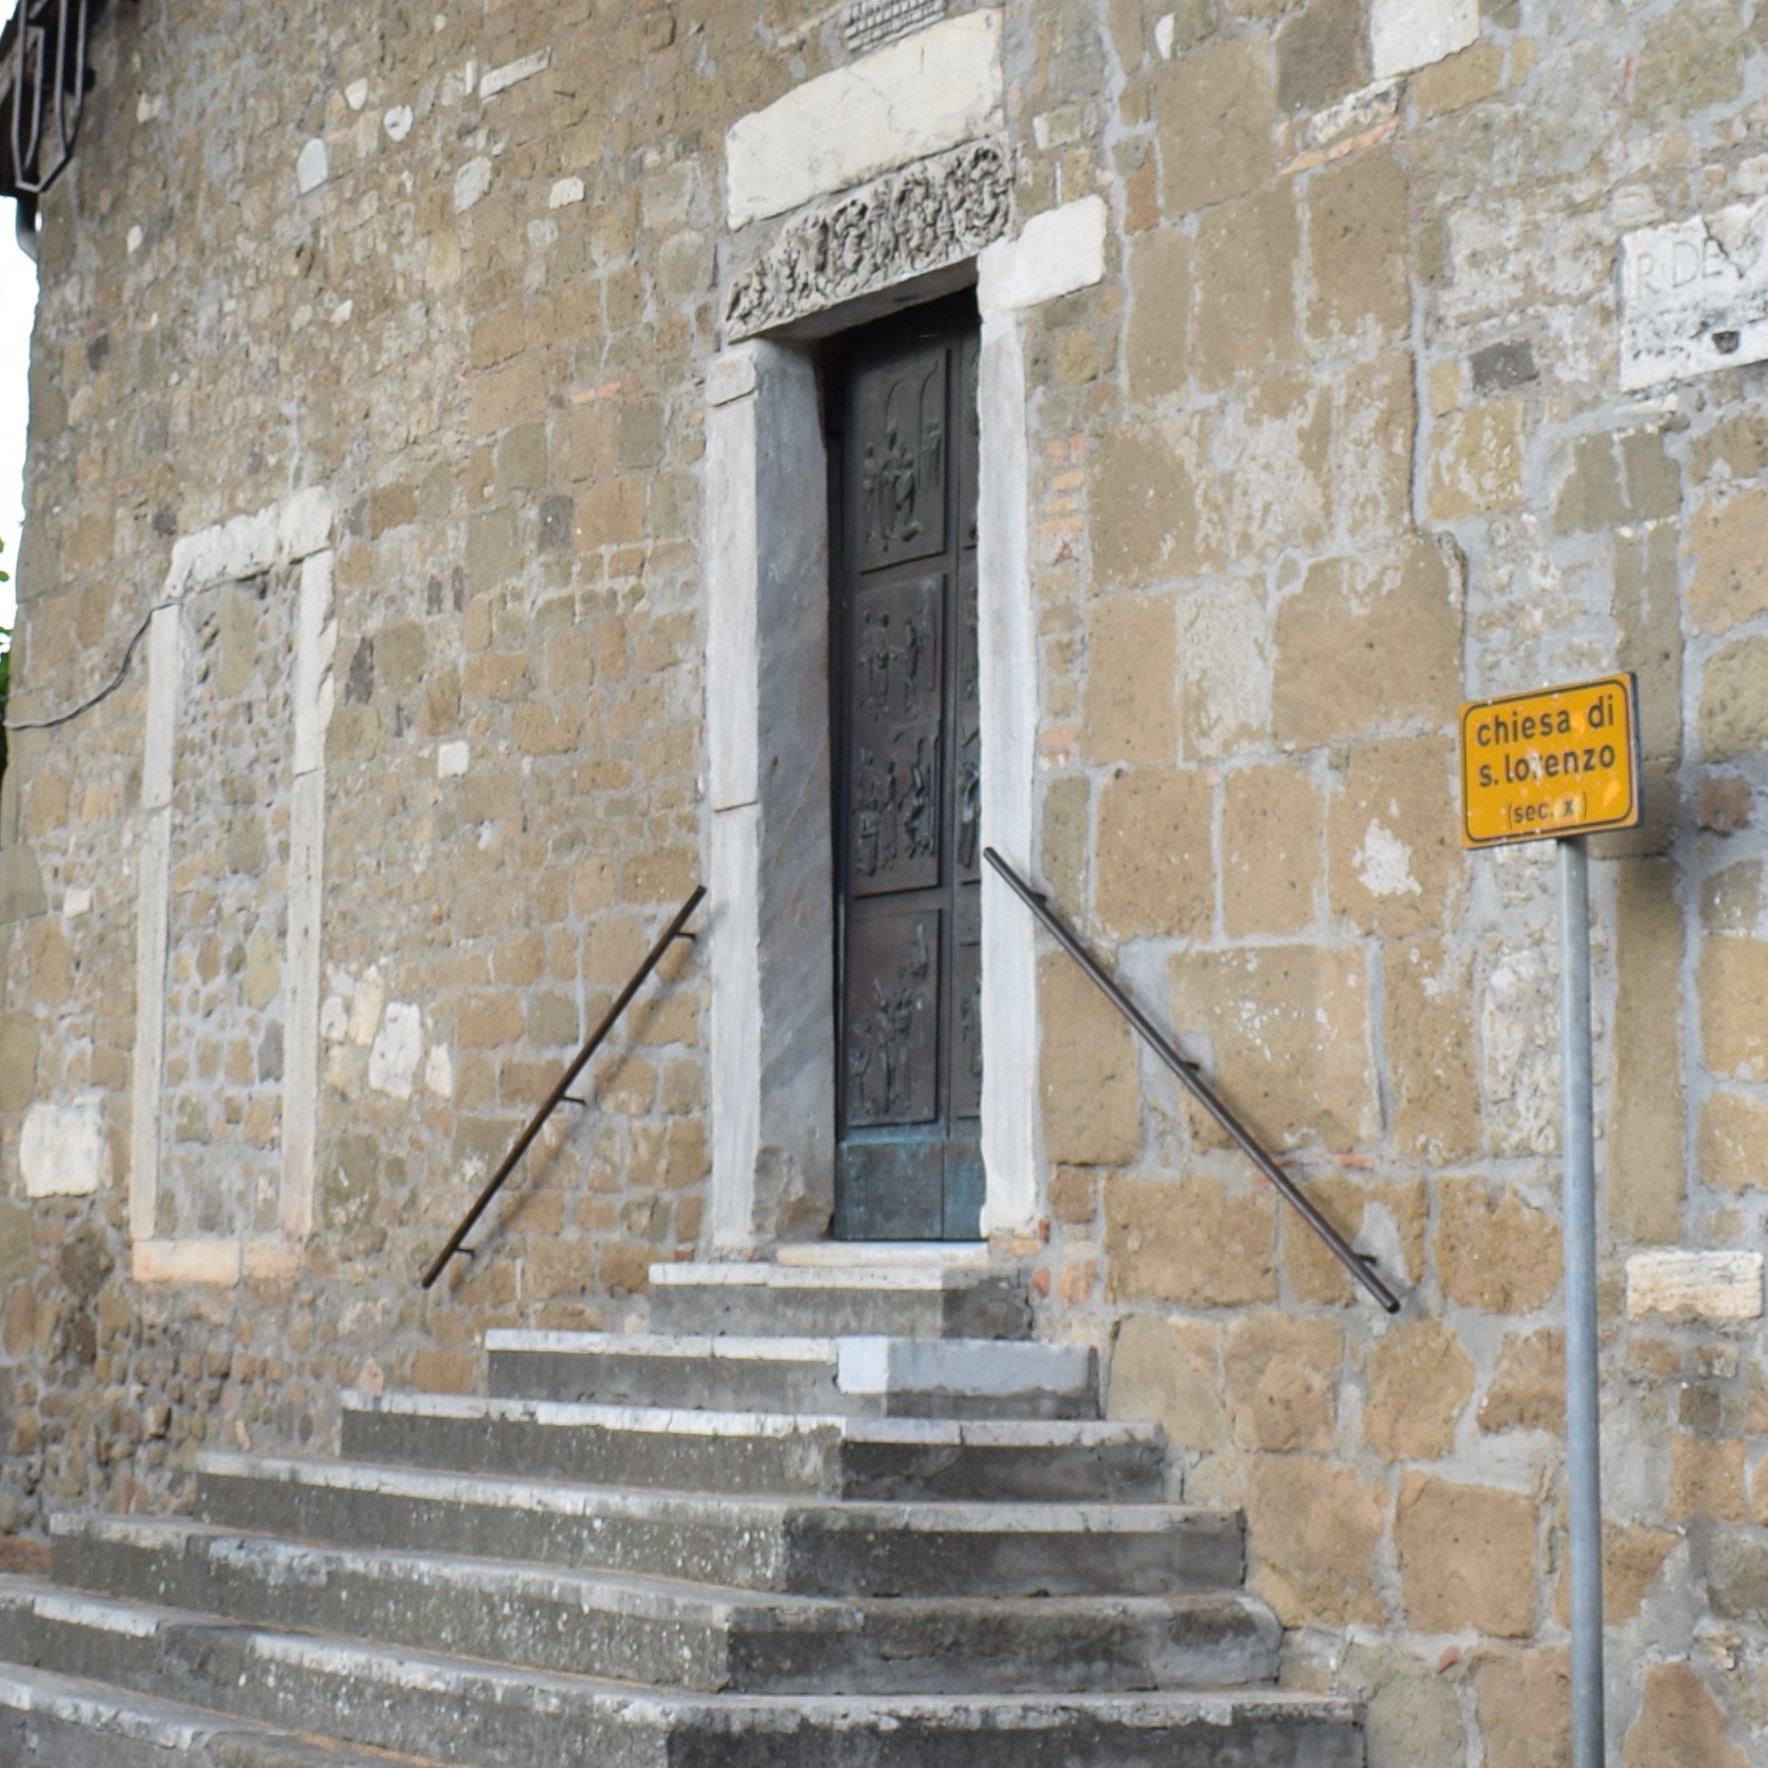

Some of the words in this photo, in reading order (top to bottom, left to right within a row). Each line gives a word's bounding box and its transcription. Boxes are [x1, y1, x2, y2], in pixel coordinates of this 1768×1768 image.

[1476, 709, 1571, 746] chiesa
[1587, 693, 1614, 729] di
[1478, 763, 1499, 787] s.
[1508, 801, 1555, 830] (sec.
